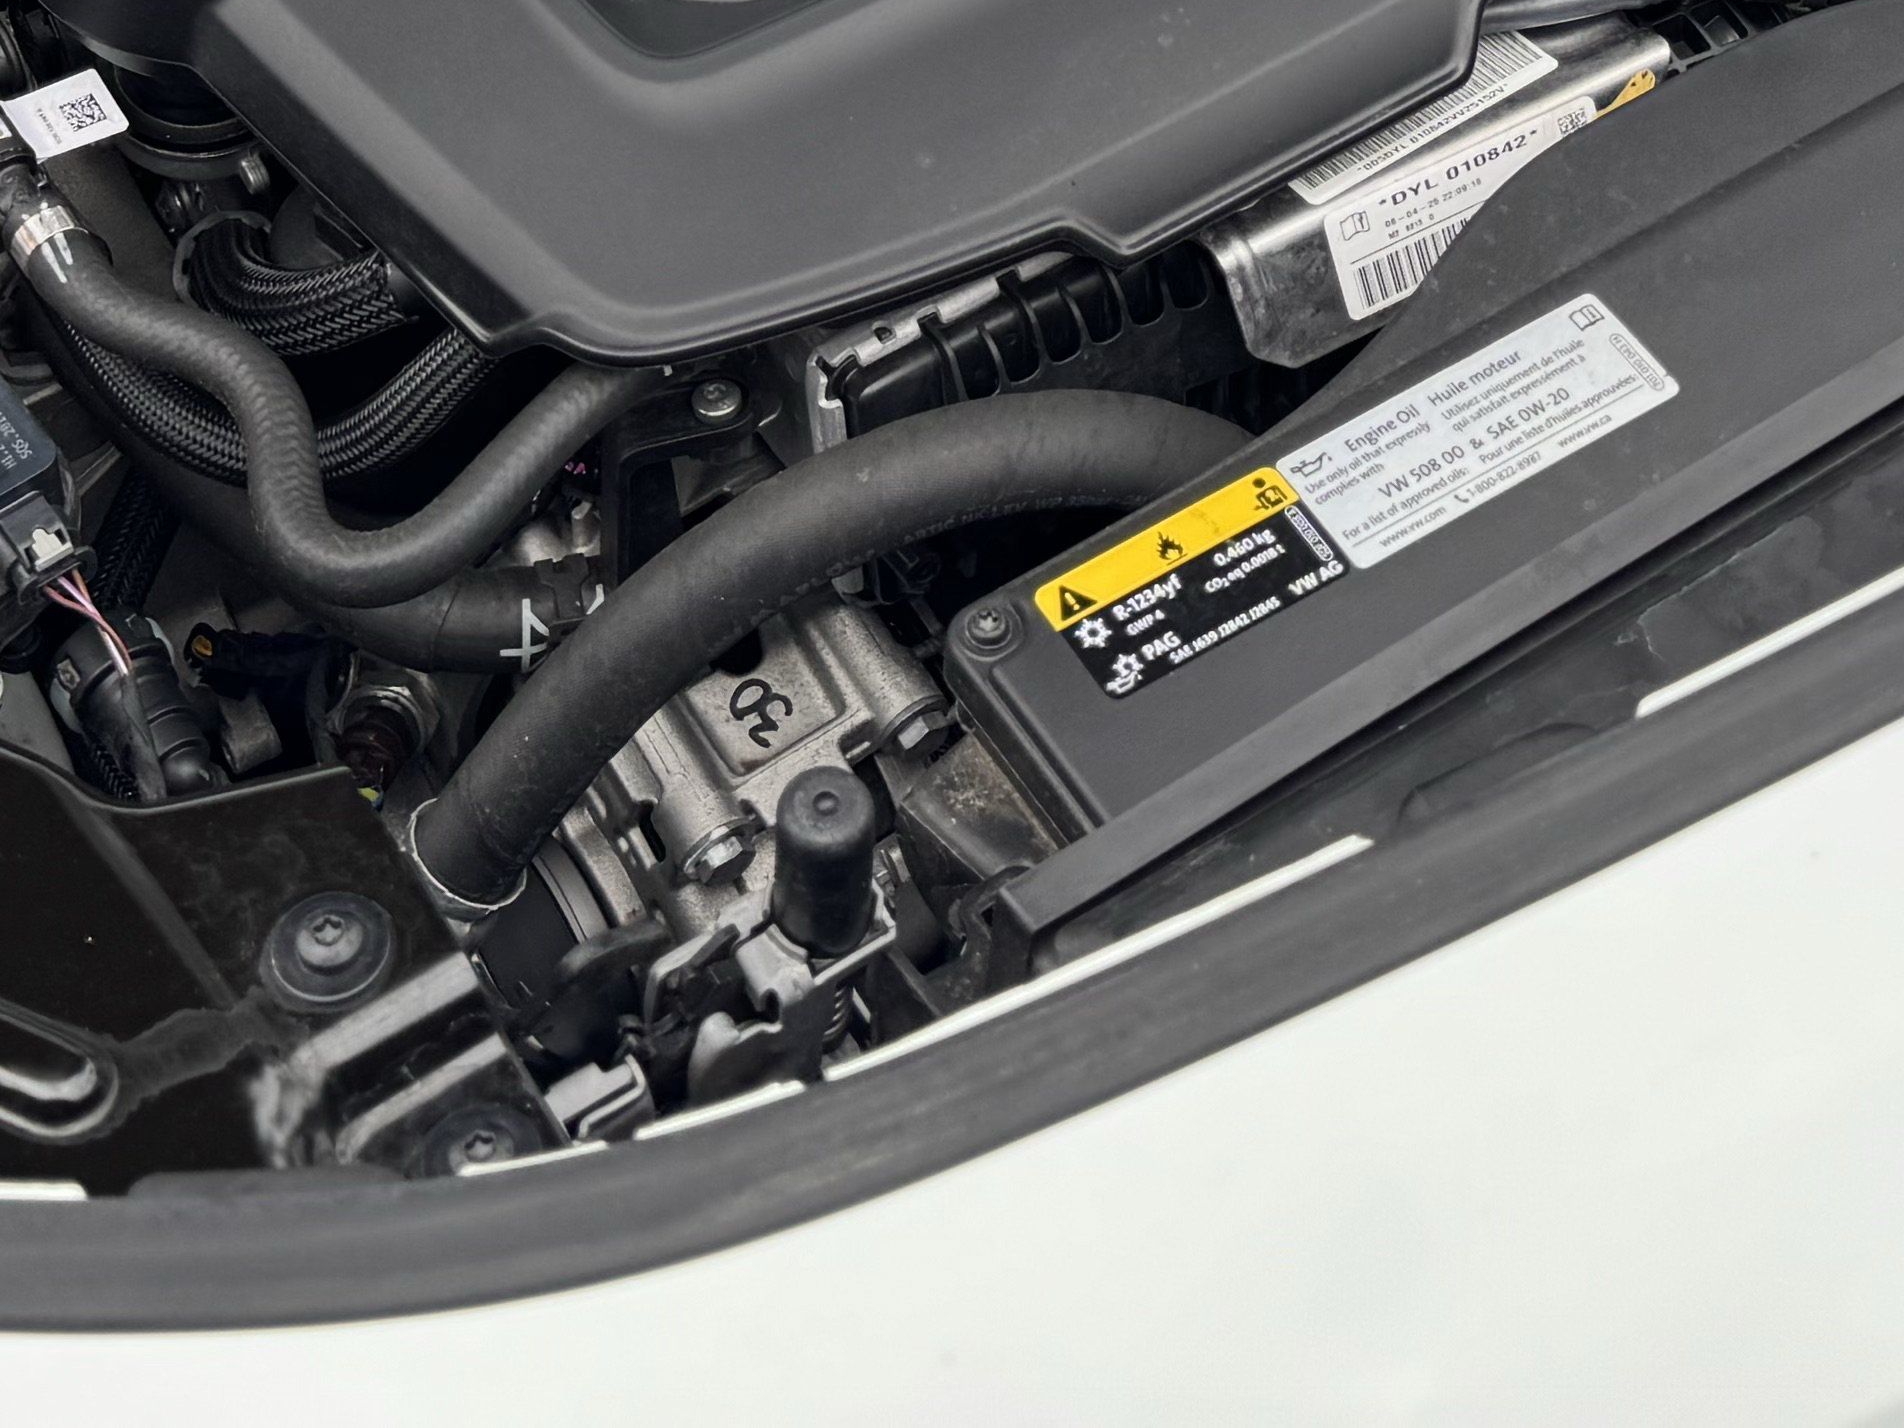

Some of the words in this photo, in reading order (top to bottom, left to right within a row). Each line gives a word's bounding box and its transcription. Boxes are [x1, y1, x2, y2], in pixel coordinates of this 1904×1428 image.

[1343, 416, 1400, 455] Engine
[1393, 403, 1421, 424] Oil
[1426, 377, 1469, 407] Huile
[1466, 349, 1524, 385] moteur
[1440, 394, 1481, 421] Utilisez
[1478, 361, 1542, 402] uniquement
[1537, 353, 1555, 367] de
[1551, 336, 1585, 360] l'huile
[1449, 416, 1472, 434] qui
[1467, 394, 1511, 422] satisfait
[1507, 357, 1579, 401] expressément
[1304, 477, 1327, 494] Use
[1324, 464, 1351, 485] only
[1346, 457, 1364, 471] oil
[1360, 445, 1386, 463] that
[1383, 419, 1433, 453] expressly
[1377, 473, 1412, 500] VW
[1407, 456, 1443, 483] 508
[1439, 443, 1467, 465] 00
[1467, 435, 1485, 450] &
[1484, 414, 1520, 440] SAE
[1515, 385, 1572, 423] 0W-20
[1478, 445, 1506, 465] Pour
[1503, 436, 1524, 451] une
[1520, 422, 1546, 441] liste
[1541, 402, 1583, 429] d'huiles
[1313, 475, 1362, 507] complies
[1358, 461, 1386, 481] with
[1341, 523, 1363, 541] For
[1367, 510, 1387, 526] list
[1384, 503, 1400, 517] of
[1396, 475, 1449, 511] approved
[1443, 463, 1470, 483] oils:
[1378, 504, 1448, 548] www.vw.com
[1556, 413, 1613, 448] www.vw.ca
[1109, 572, 1187, 624] R-1234yf
[1250, 525, 1277, 548] kg
[1167, 644, 1194, 665] SAE
[1287, 571, 1321, 598] VW
[1315, 557, 1345, 582] AG
[1123, 613, 1157, 637] GWP
[1139, 629, 1183, 662] PAG
